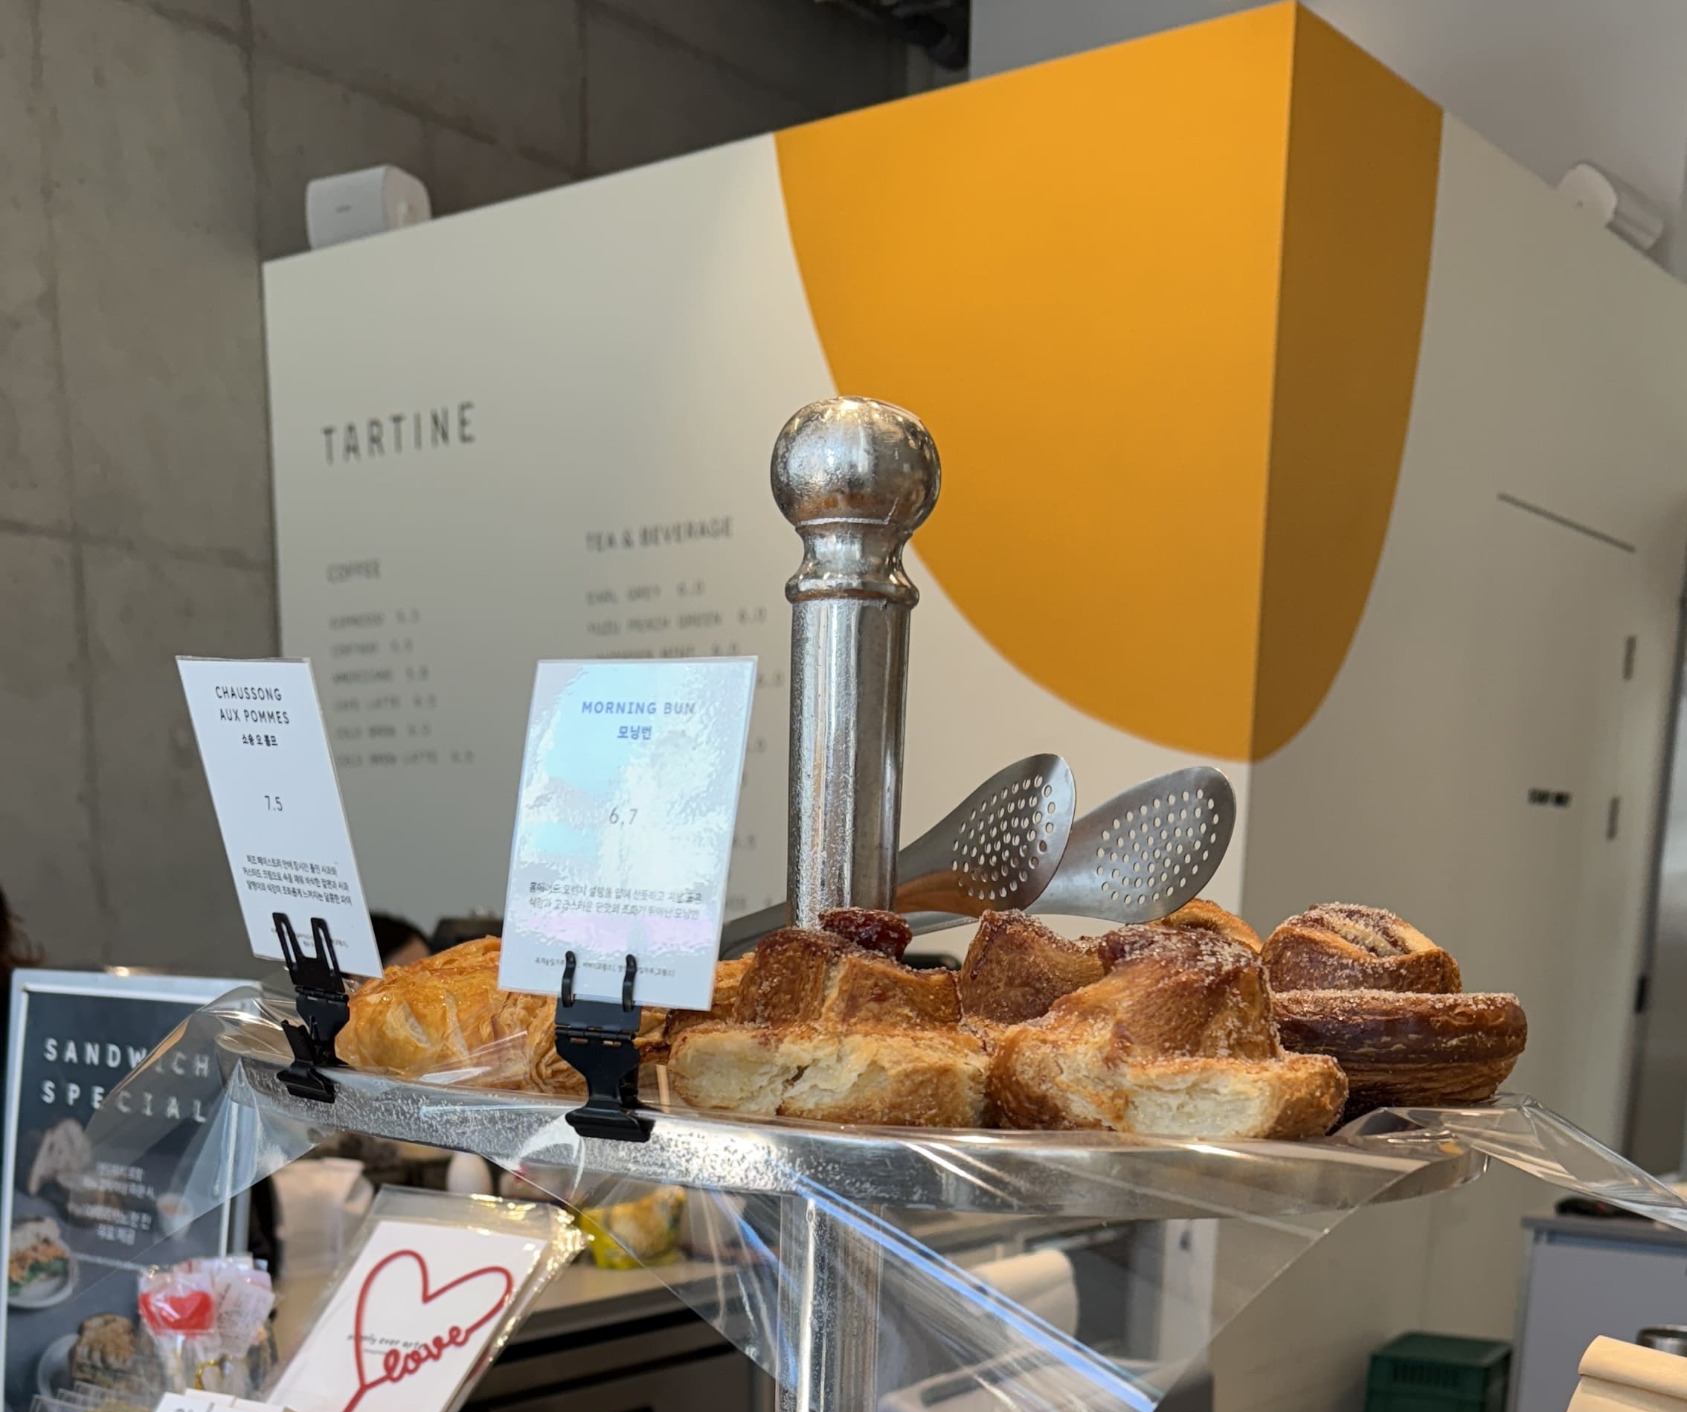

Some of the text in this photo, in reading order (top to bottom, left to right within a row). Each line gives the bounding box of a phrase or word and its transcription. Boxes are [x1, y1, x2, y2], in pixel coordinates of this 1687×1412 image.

[321, 402, 477, 464] TARTINE
[641, 516, 733, 546] BEVERAGE
[215, 686, 282, 701] CHAUSSONG
[220, 708, 290, 724] AUX POMMES
[582, 701, 696, 715] MORNING BUN
[617, 726, 653, 740] 모닝번
[264, 795, 283, 812] 7.5
[609, 808, 638, 826] 6.7
[41, 1080, 207, 1122] SPECIAL
